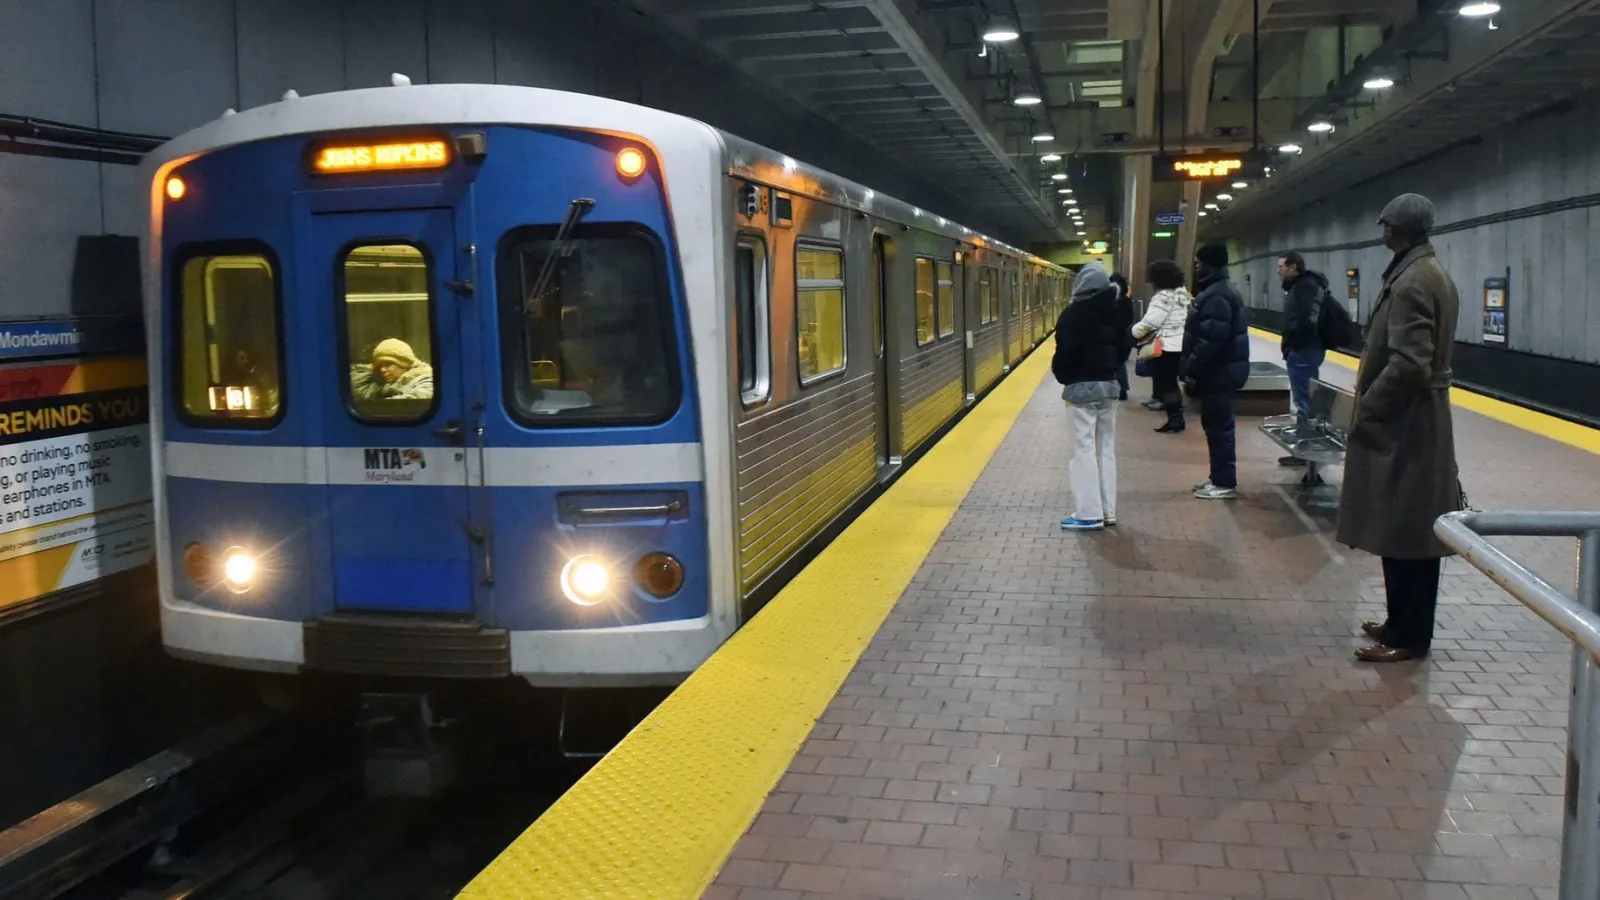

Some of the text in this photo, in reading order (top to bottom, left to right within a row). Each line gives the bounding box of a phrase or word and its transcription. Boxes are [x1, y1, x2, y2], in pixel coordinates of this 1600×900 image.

[0, 404, 94, 436] REMINDS
[1, 456, 17, 468] no
[20, 445, 74, 463] drinking,
[76, 442, 90, 455] no
[364, 448, 403, 470] MTA
[15, 471, 28, 484] or
[32, 460, 76, 481] playing
[78, 455, 112, 472] music
[4, 472, 111, 506] earphones in MTA
[6, 506, 30, 523] and
[33, 496, 87, 518] stations.
